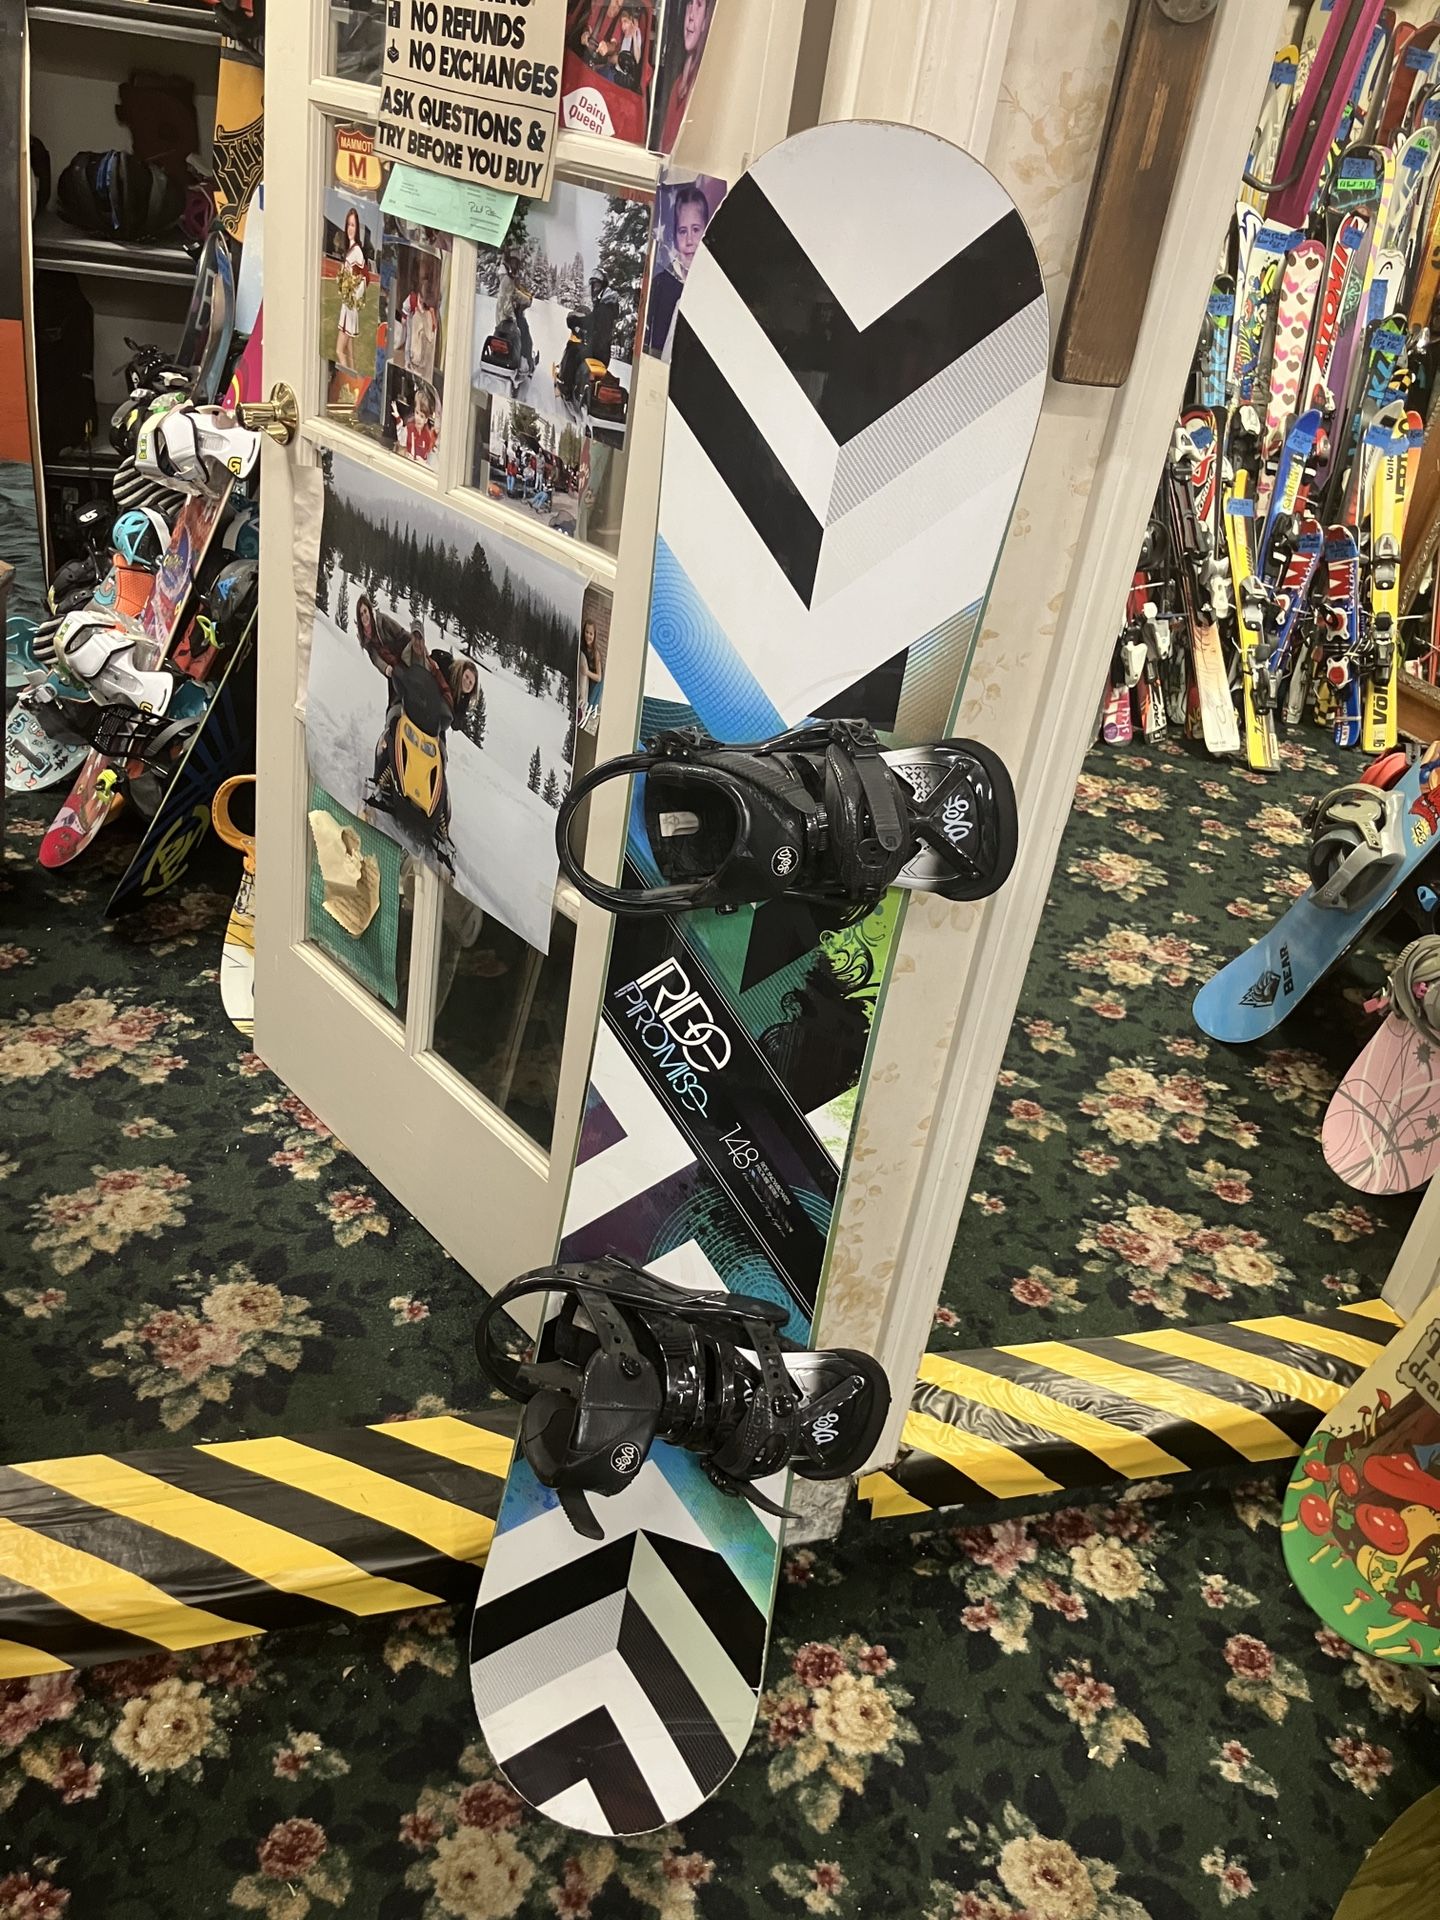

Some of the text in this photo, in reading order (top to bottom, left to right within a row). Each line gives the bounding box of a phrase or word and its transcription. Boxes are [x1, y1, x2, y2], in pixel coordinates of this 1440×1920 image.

[411, 1, 526, 50] NO REFUNDS
[409, 39, 560, 98] NO EXCHANGES
[380, 86, 547, 152] ASK QUESTIONS &
[569, 104, 602, 135] Queen
[579, 96, 606, 125] Dairy
[349, 153, 367, 179] M
[378, 121, 544, 188] TRY BEFORE YOU BUY
[1315, 241, 1349, 373] ATOMI
[1280, 942, 1294, 996] BEAR
[636, 956, 732, 1072] RIDE
[614, 981, 708, 1118] PROMISE
[719, 1122, 759, 1169] 148
[1409, 1359, 1440, 1402] dra
